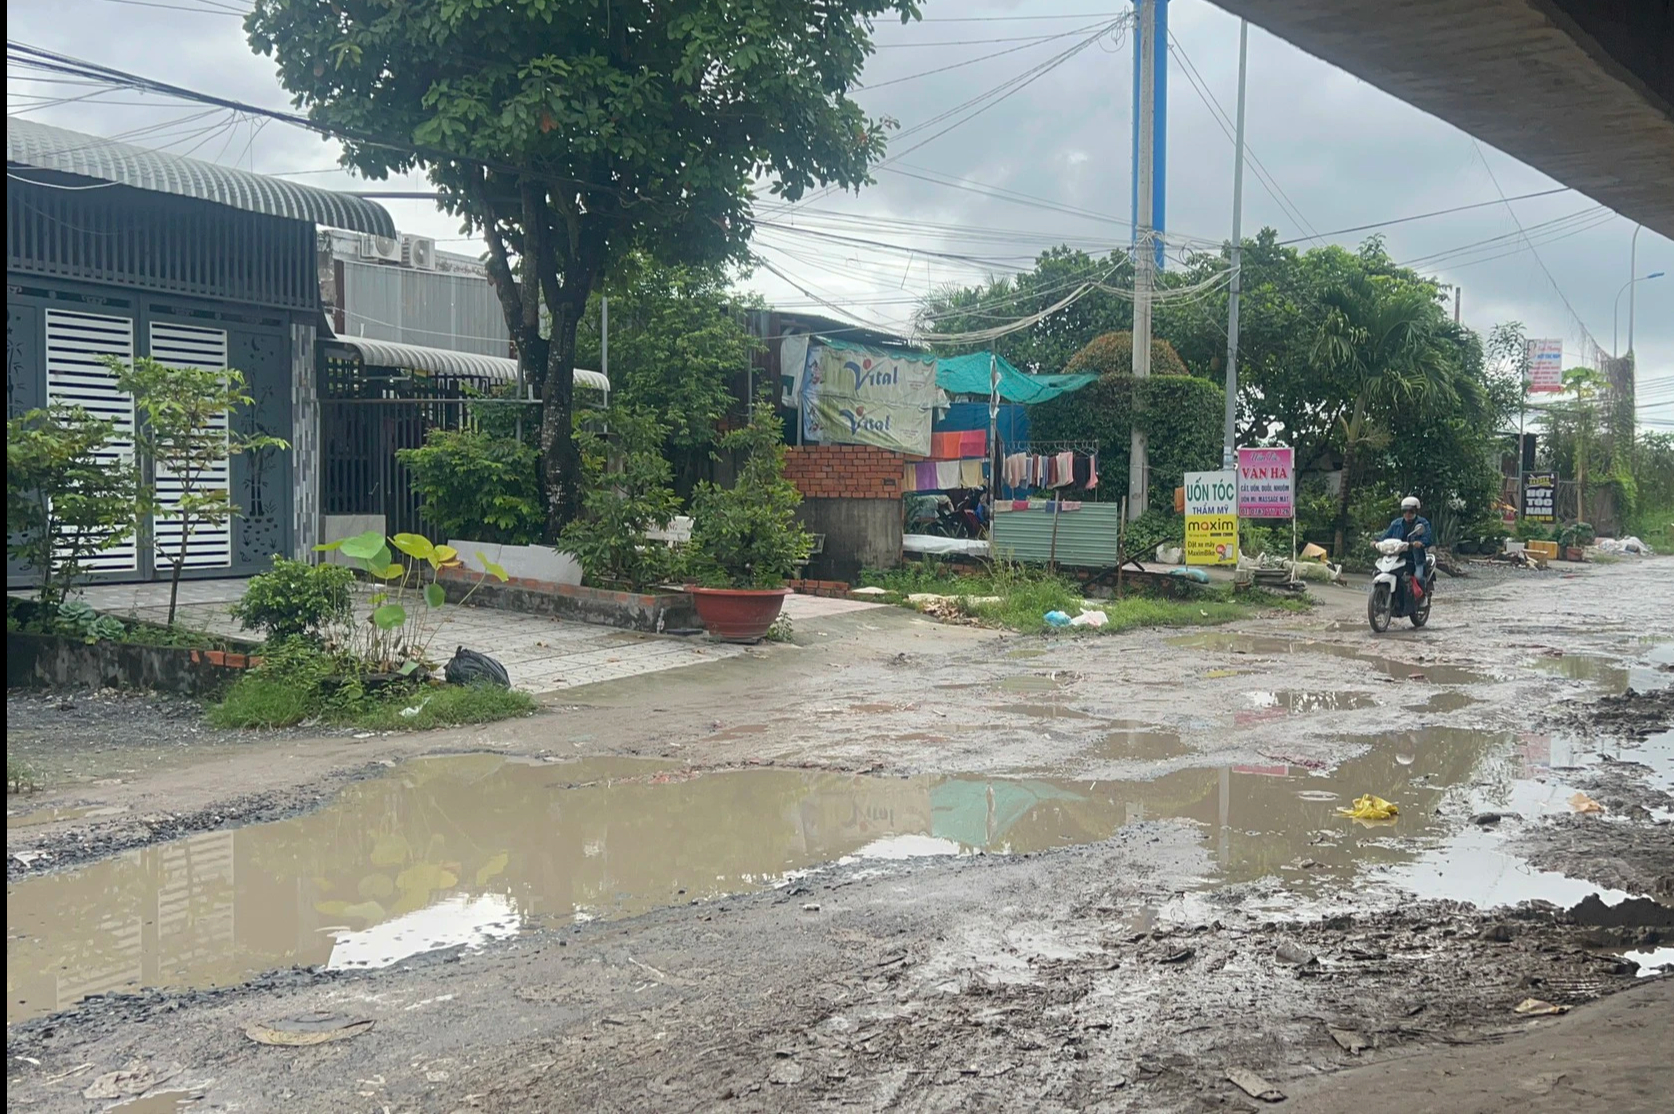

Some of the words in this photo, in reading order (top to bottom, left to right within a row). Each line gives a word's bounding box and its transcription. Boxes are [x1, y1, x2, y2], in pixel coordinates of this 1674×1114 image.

[844, 358, 898, 390] Vital
[840, 406, 890, 436] Vital
[1187, 477, 1209, 502] UỐN
[1212, 478, 1234, 501] TÓC
[1192, 502, 1215, 515] THẨM
[1217, 504, 1229, 515] MỸ
[1525, 507, 1552, 515] NAM
[1188, 518, 1234, 531] maxim
